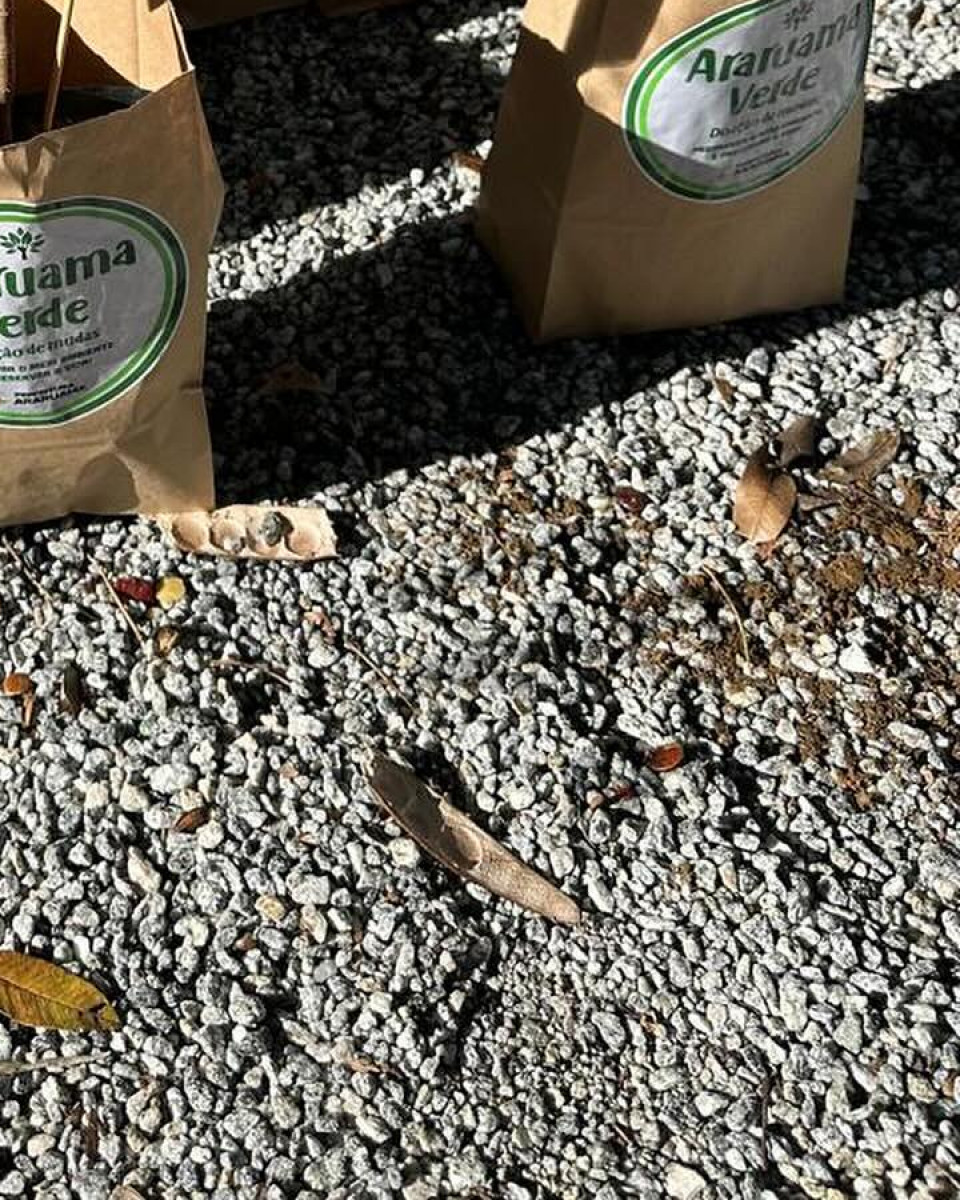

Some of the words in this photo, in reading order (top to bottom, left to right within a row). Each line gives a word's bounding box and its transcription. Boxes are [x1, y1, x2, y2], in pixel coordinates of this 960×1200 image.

[730, 66, 821, 115] Verde
[26, 343, 45, 356] de
[47, 329, 101, 353] mudas
